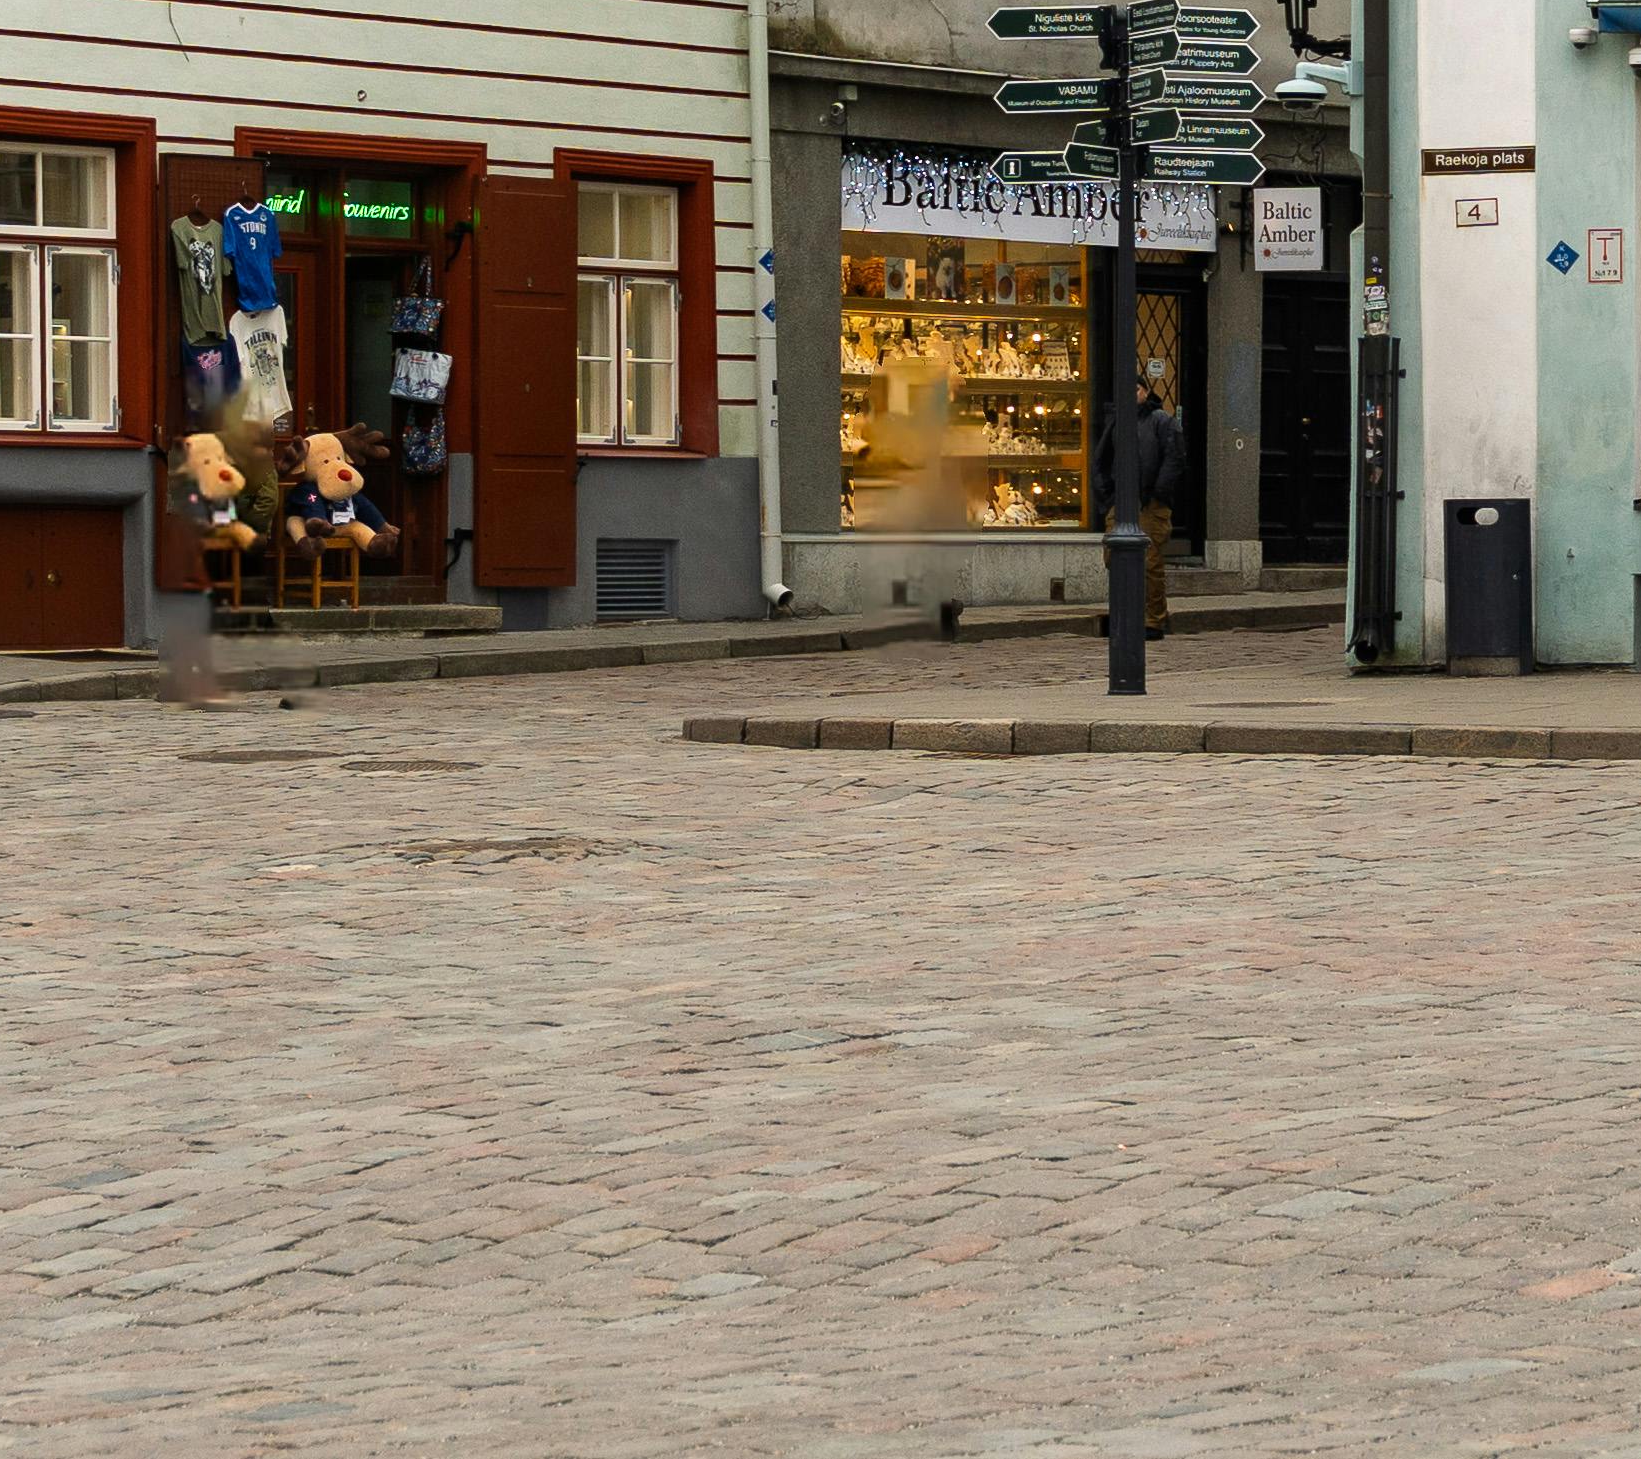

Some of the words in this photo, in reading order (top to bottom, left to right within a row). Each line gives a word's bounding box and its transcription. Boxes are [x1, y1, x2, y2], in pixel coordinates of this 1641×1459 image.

[1058, 85, 1098, 95] VABAMU
[1177, 86, 1251, 96] Ajaloomuuseum
[1185, 98, 1210, 106] History
[1154, 157, 1215, 168] Raudteejaam
[1435, 153, 1488, 168] Raekoja
[1493, 151, 1525, 167] plats
[1182, 169, 1207, 177] Station
[882, 163, 1008, 212] Baltic
[1263, 201, 1312, 220] Baltic
[1467, 203, 1481, 221] 4
[1259, 224, 1316, 242] Amber
